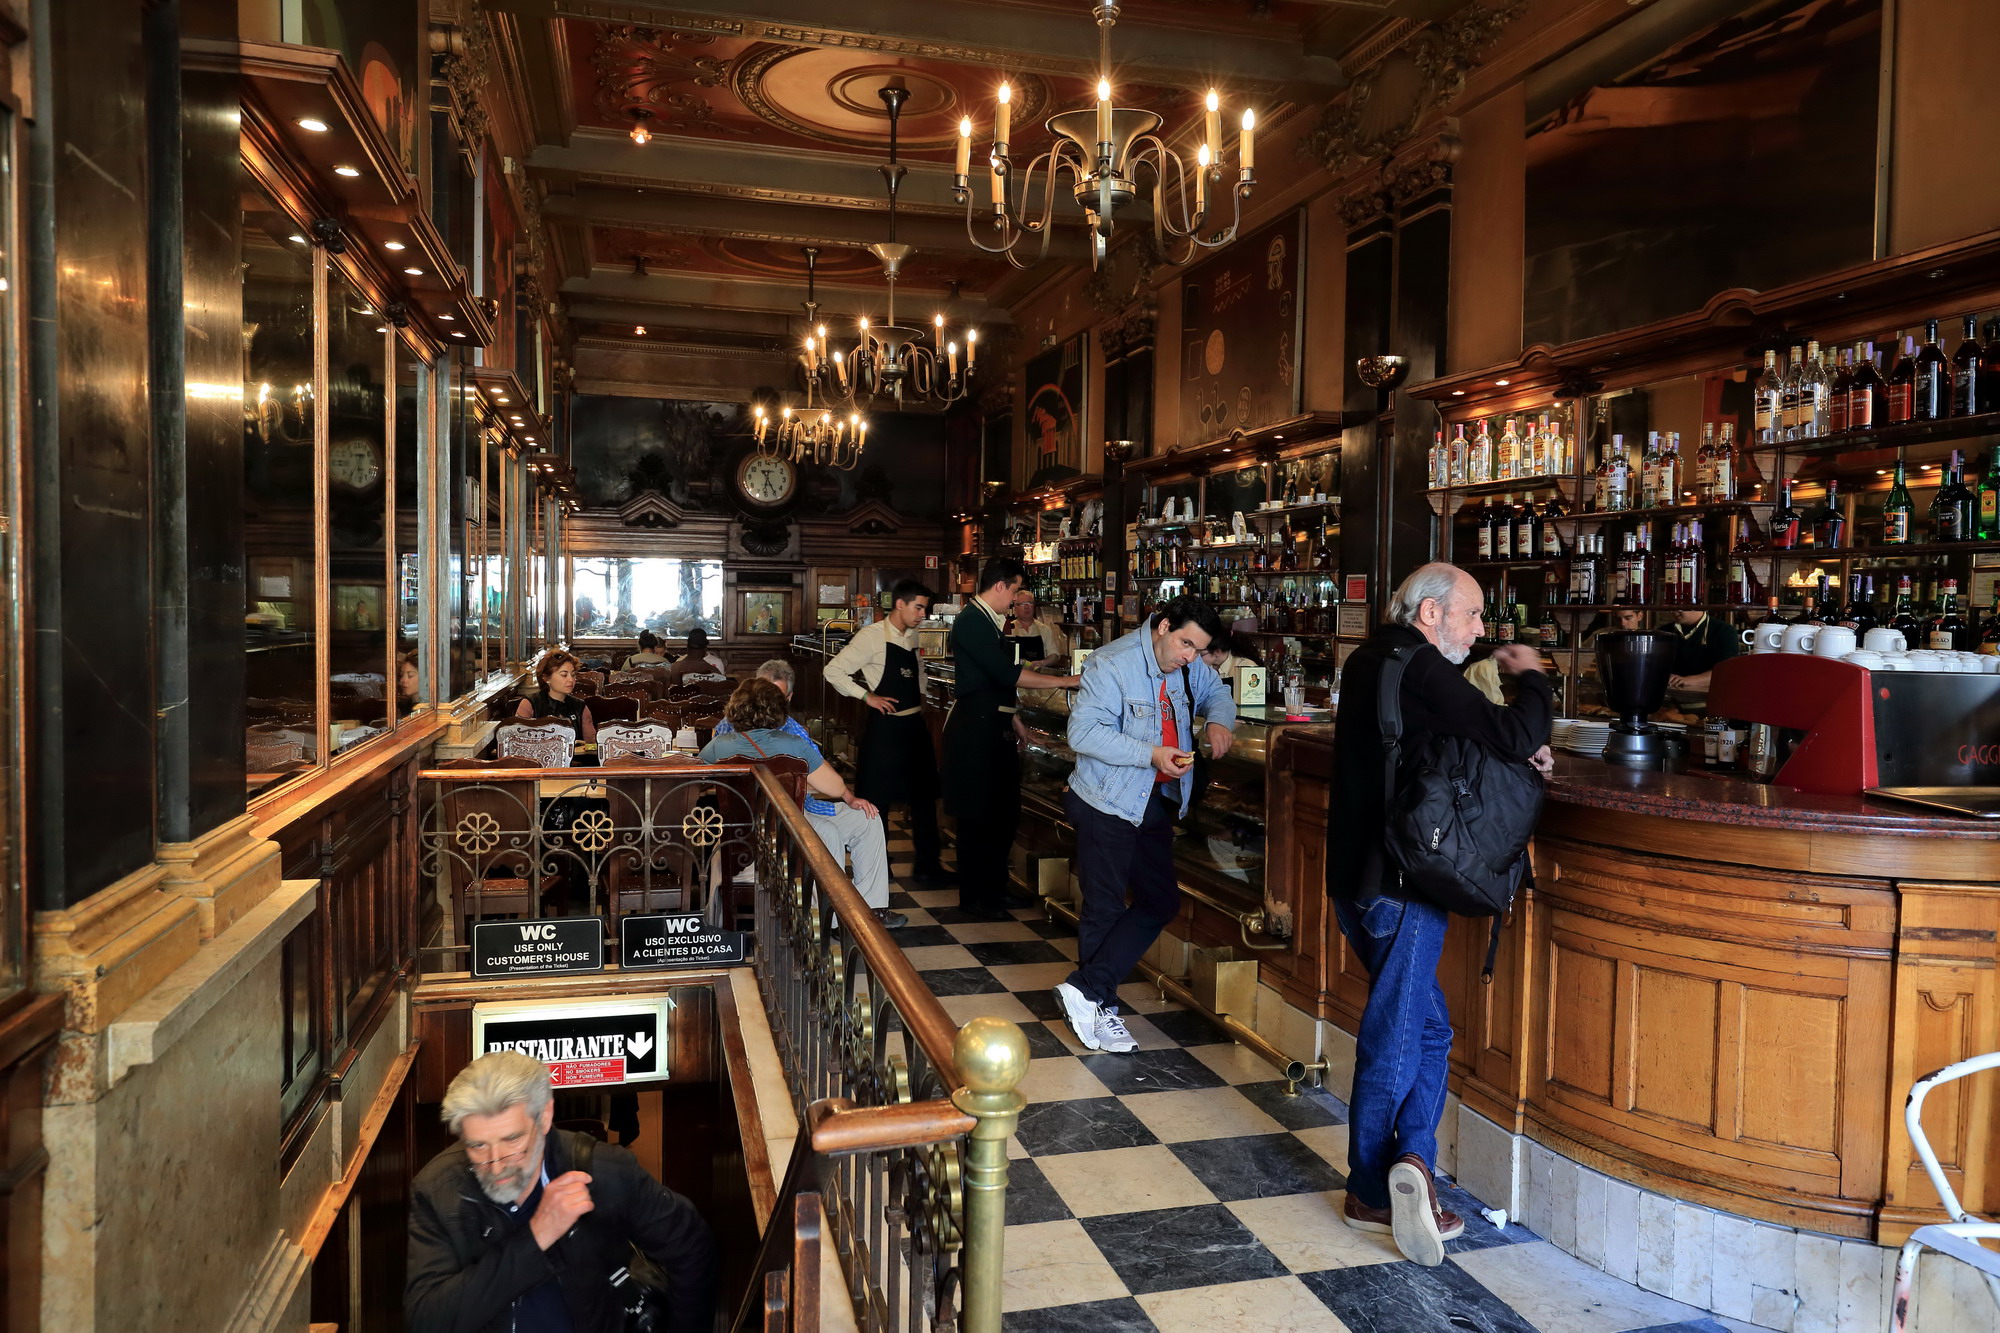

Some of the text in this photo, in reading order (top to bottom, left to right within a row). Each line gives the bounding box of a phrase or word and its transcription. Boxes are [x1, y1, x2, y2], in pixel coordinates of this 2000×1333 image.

[1957, 744, 2000, 765] GAGG
[520, 924, 557, 941] WC
[665, 917, 700, 934] WC
[645, 933, 722, 947] USO EXCLUSIVO
[513, 942, 564, 953] USE ONLY
[633, 944, 733, 958] A CLIENTES DA CASA
[486, 952, 590, 966] CUSTOMER'S HOUSE
